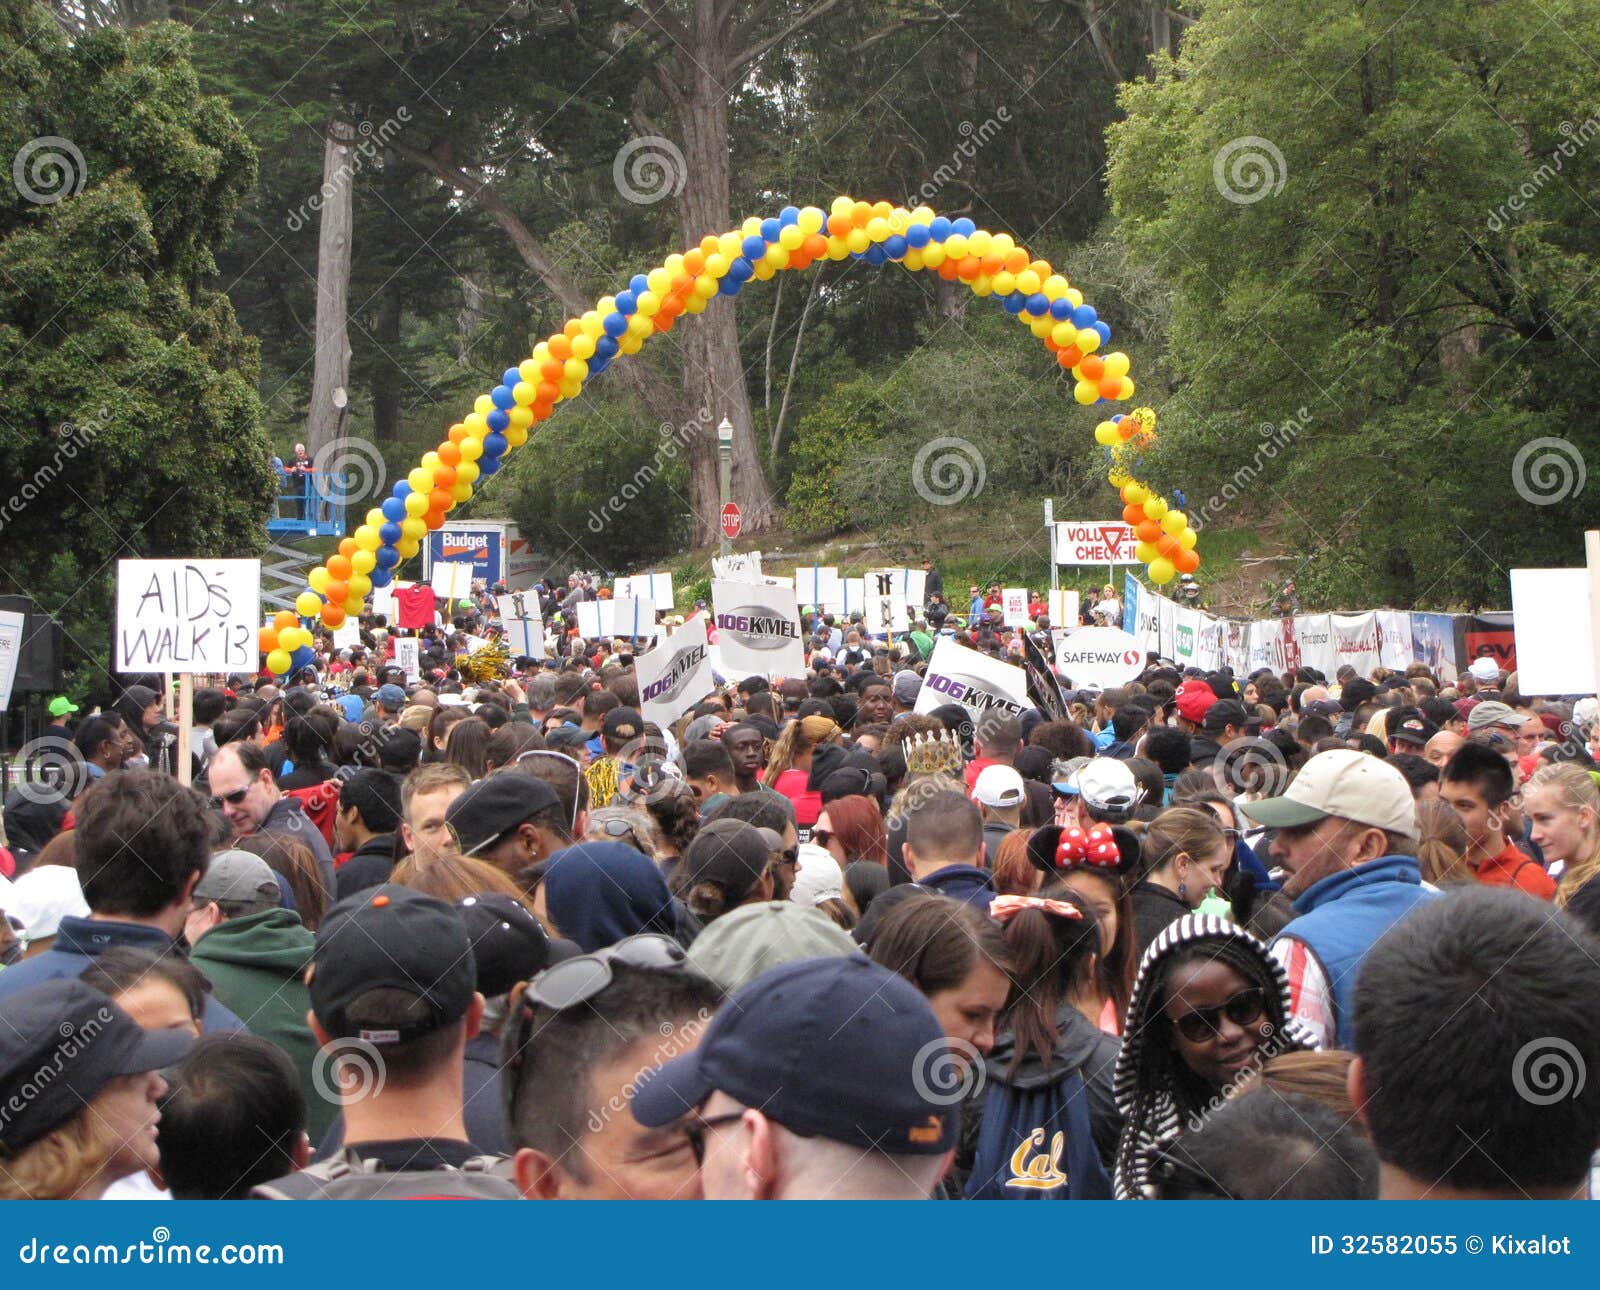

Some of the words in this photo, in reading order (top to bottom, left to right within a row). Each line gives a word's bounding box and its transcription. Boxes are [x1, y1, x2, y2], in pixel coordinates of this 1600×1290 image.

[722, 513, 740, 527] STOP
[442, 532, 488, 550] Budget
[123, 624, 210, 667] WALK
[1063, 652, 1122, 663] SAFEWAY
[1005, 1127, 1067, 1189] Cal
